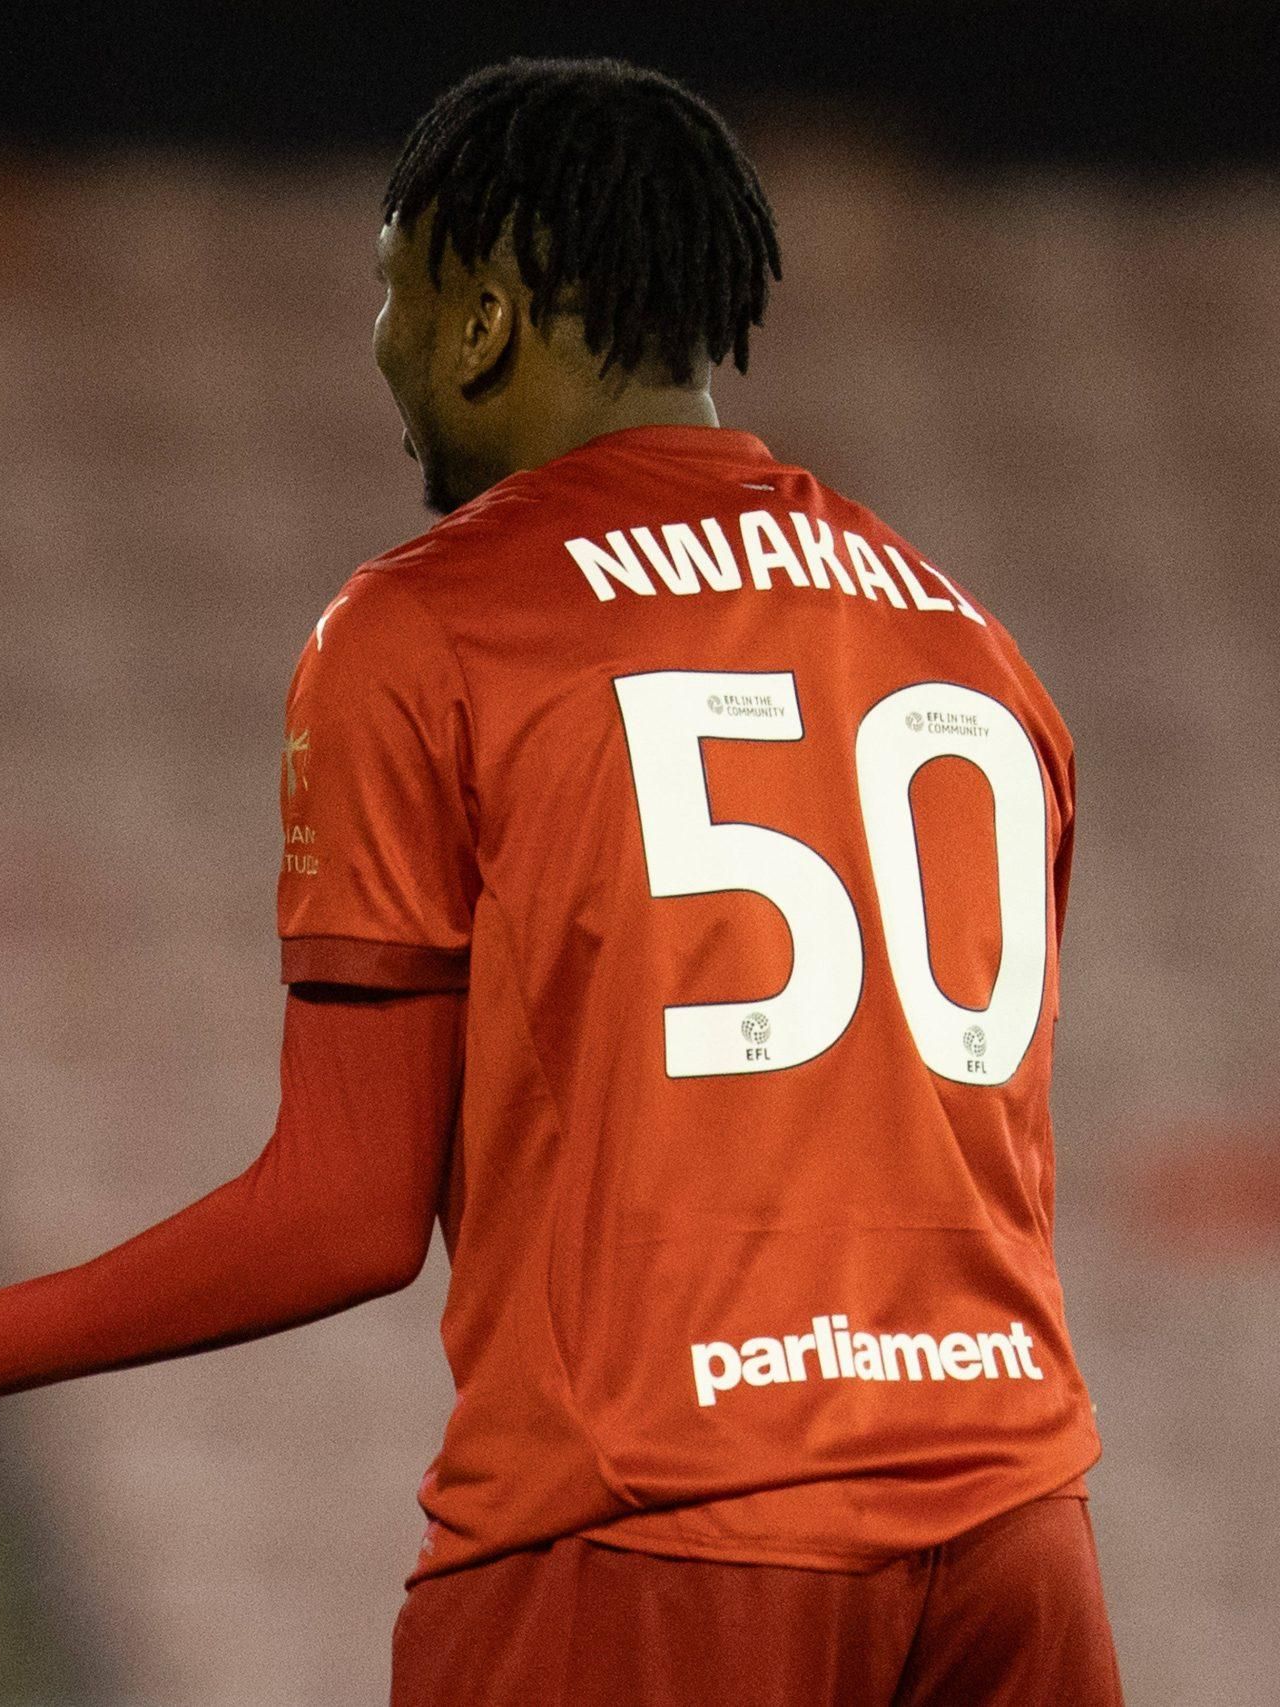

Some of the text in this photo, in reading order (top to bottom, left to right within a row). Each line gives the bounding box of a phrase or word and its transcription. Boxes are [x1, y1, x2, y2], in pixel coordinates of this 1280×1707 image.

[724, 695, 773, 706] EFL IN THE
[727, 706, 785, 717] COMMUNITY
[927, 712, 977, 726] EFL IN THE
[928, 722, 989, 737] COMMUNITY
[613, 670, 1047, 1086] 50
[746, 1048, 771, 1061] EFL
[967, 1060, 987, 1074] EFL
[691, 1314, 1044, 1407] parliament
